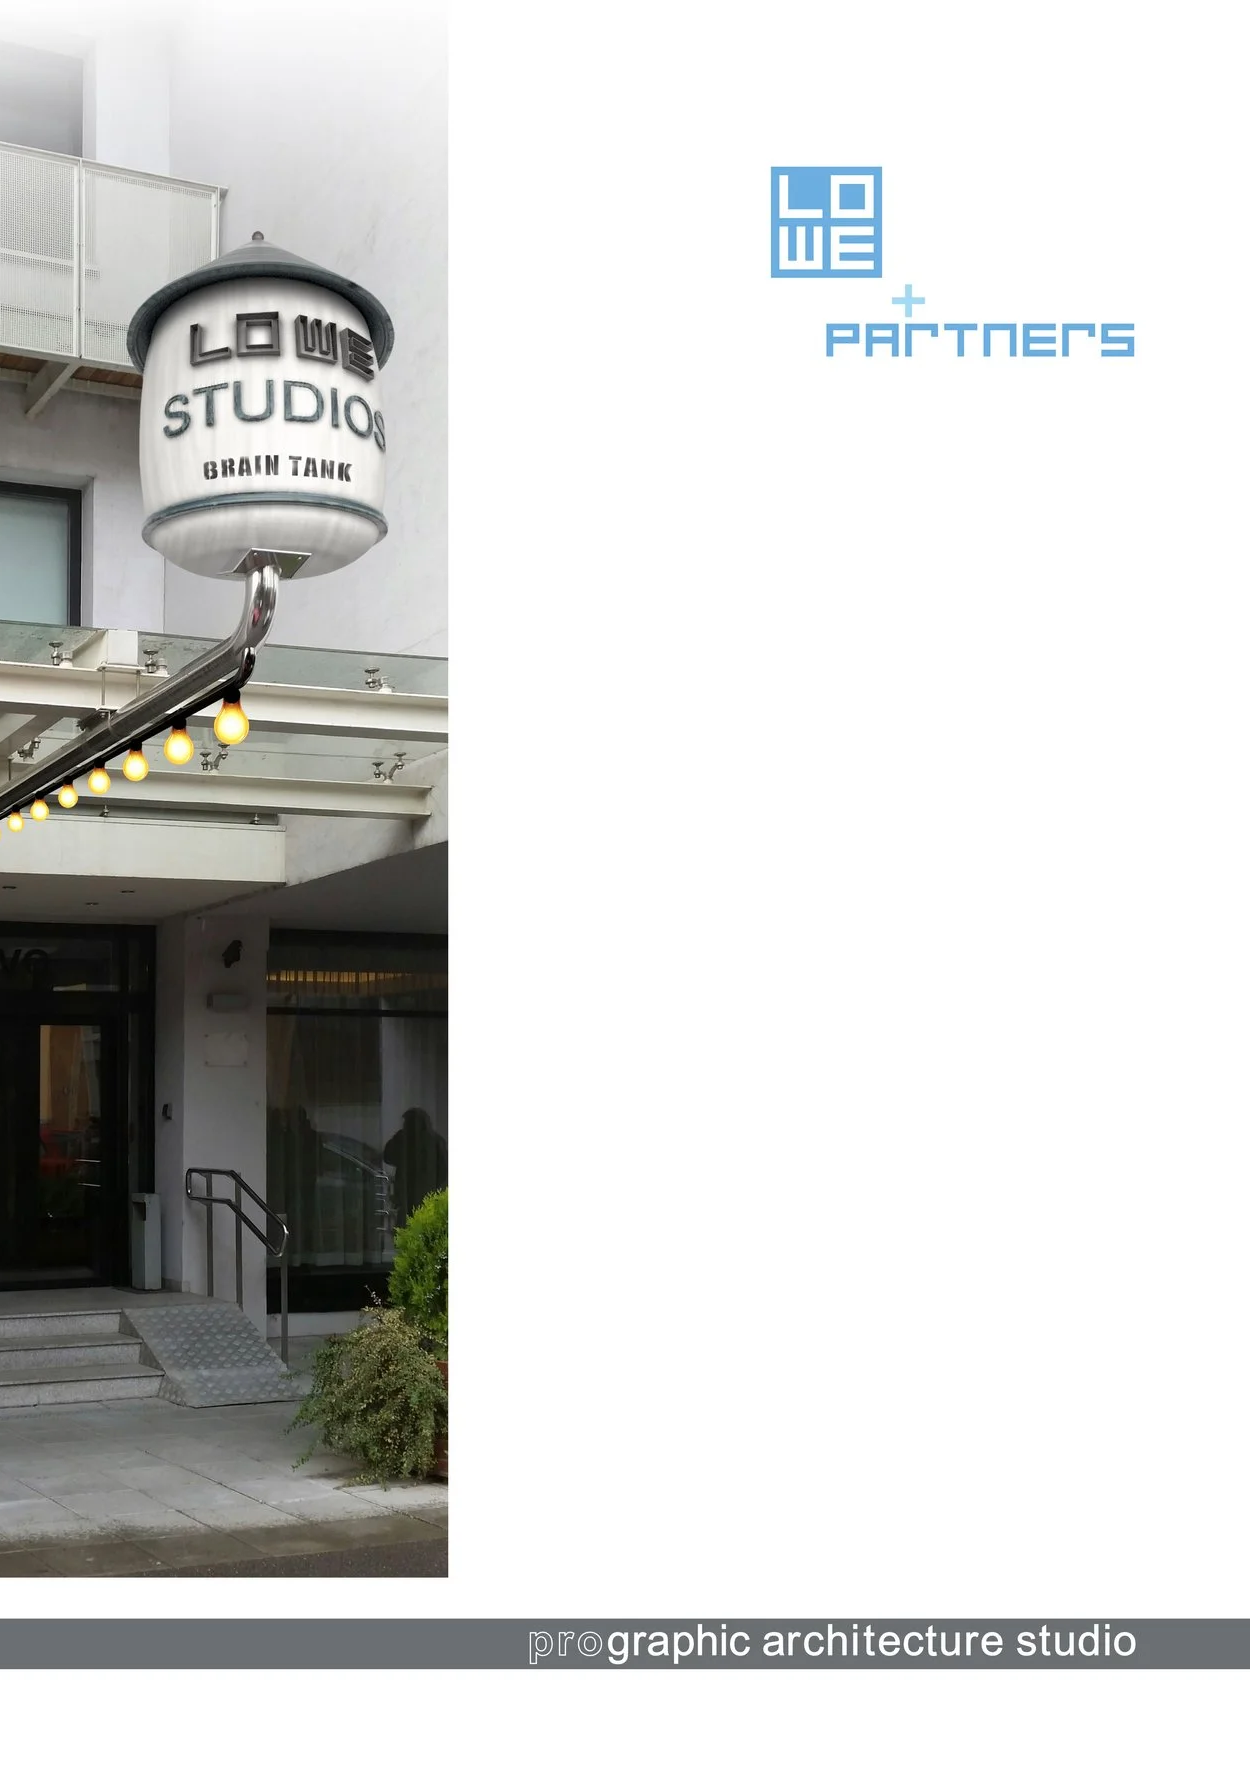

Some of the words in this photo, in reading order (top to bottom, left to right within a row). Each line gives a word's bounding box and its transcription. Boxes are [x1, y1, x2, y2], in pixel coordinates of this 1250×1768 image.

[163, 380, 386, 452] STUDIOS
[203, 455, 279, 480] BRAIN
[288, 455, 352, 482] TANK
